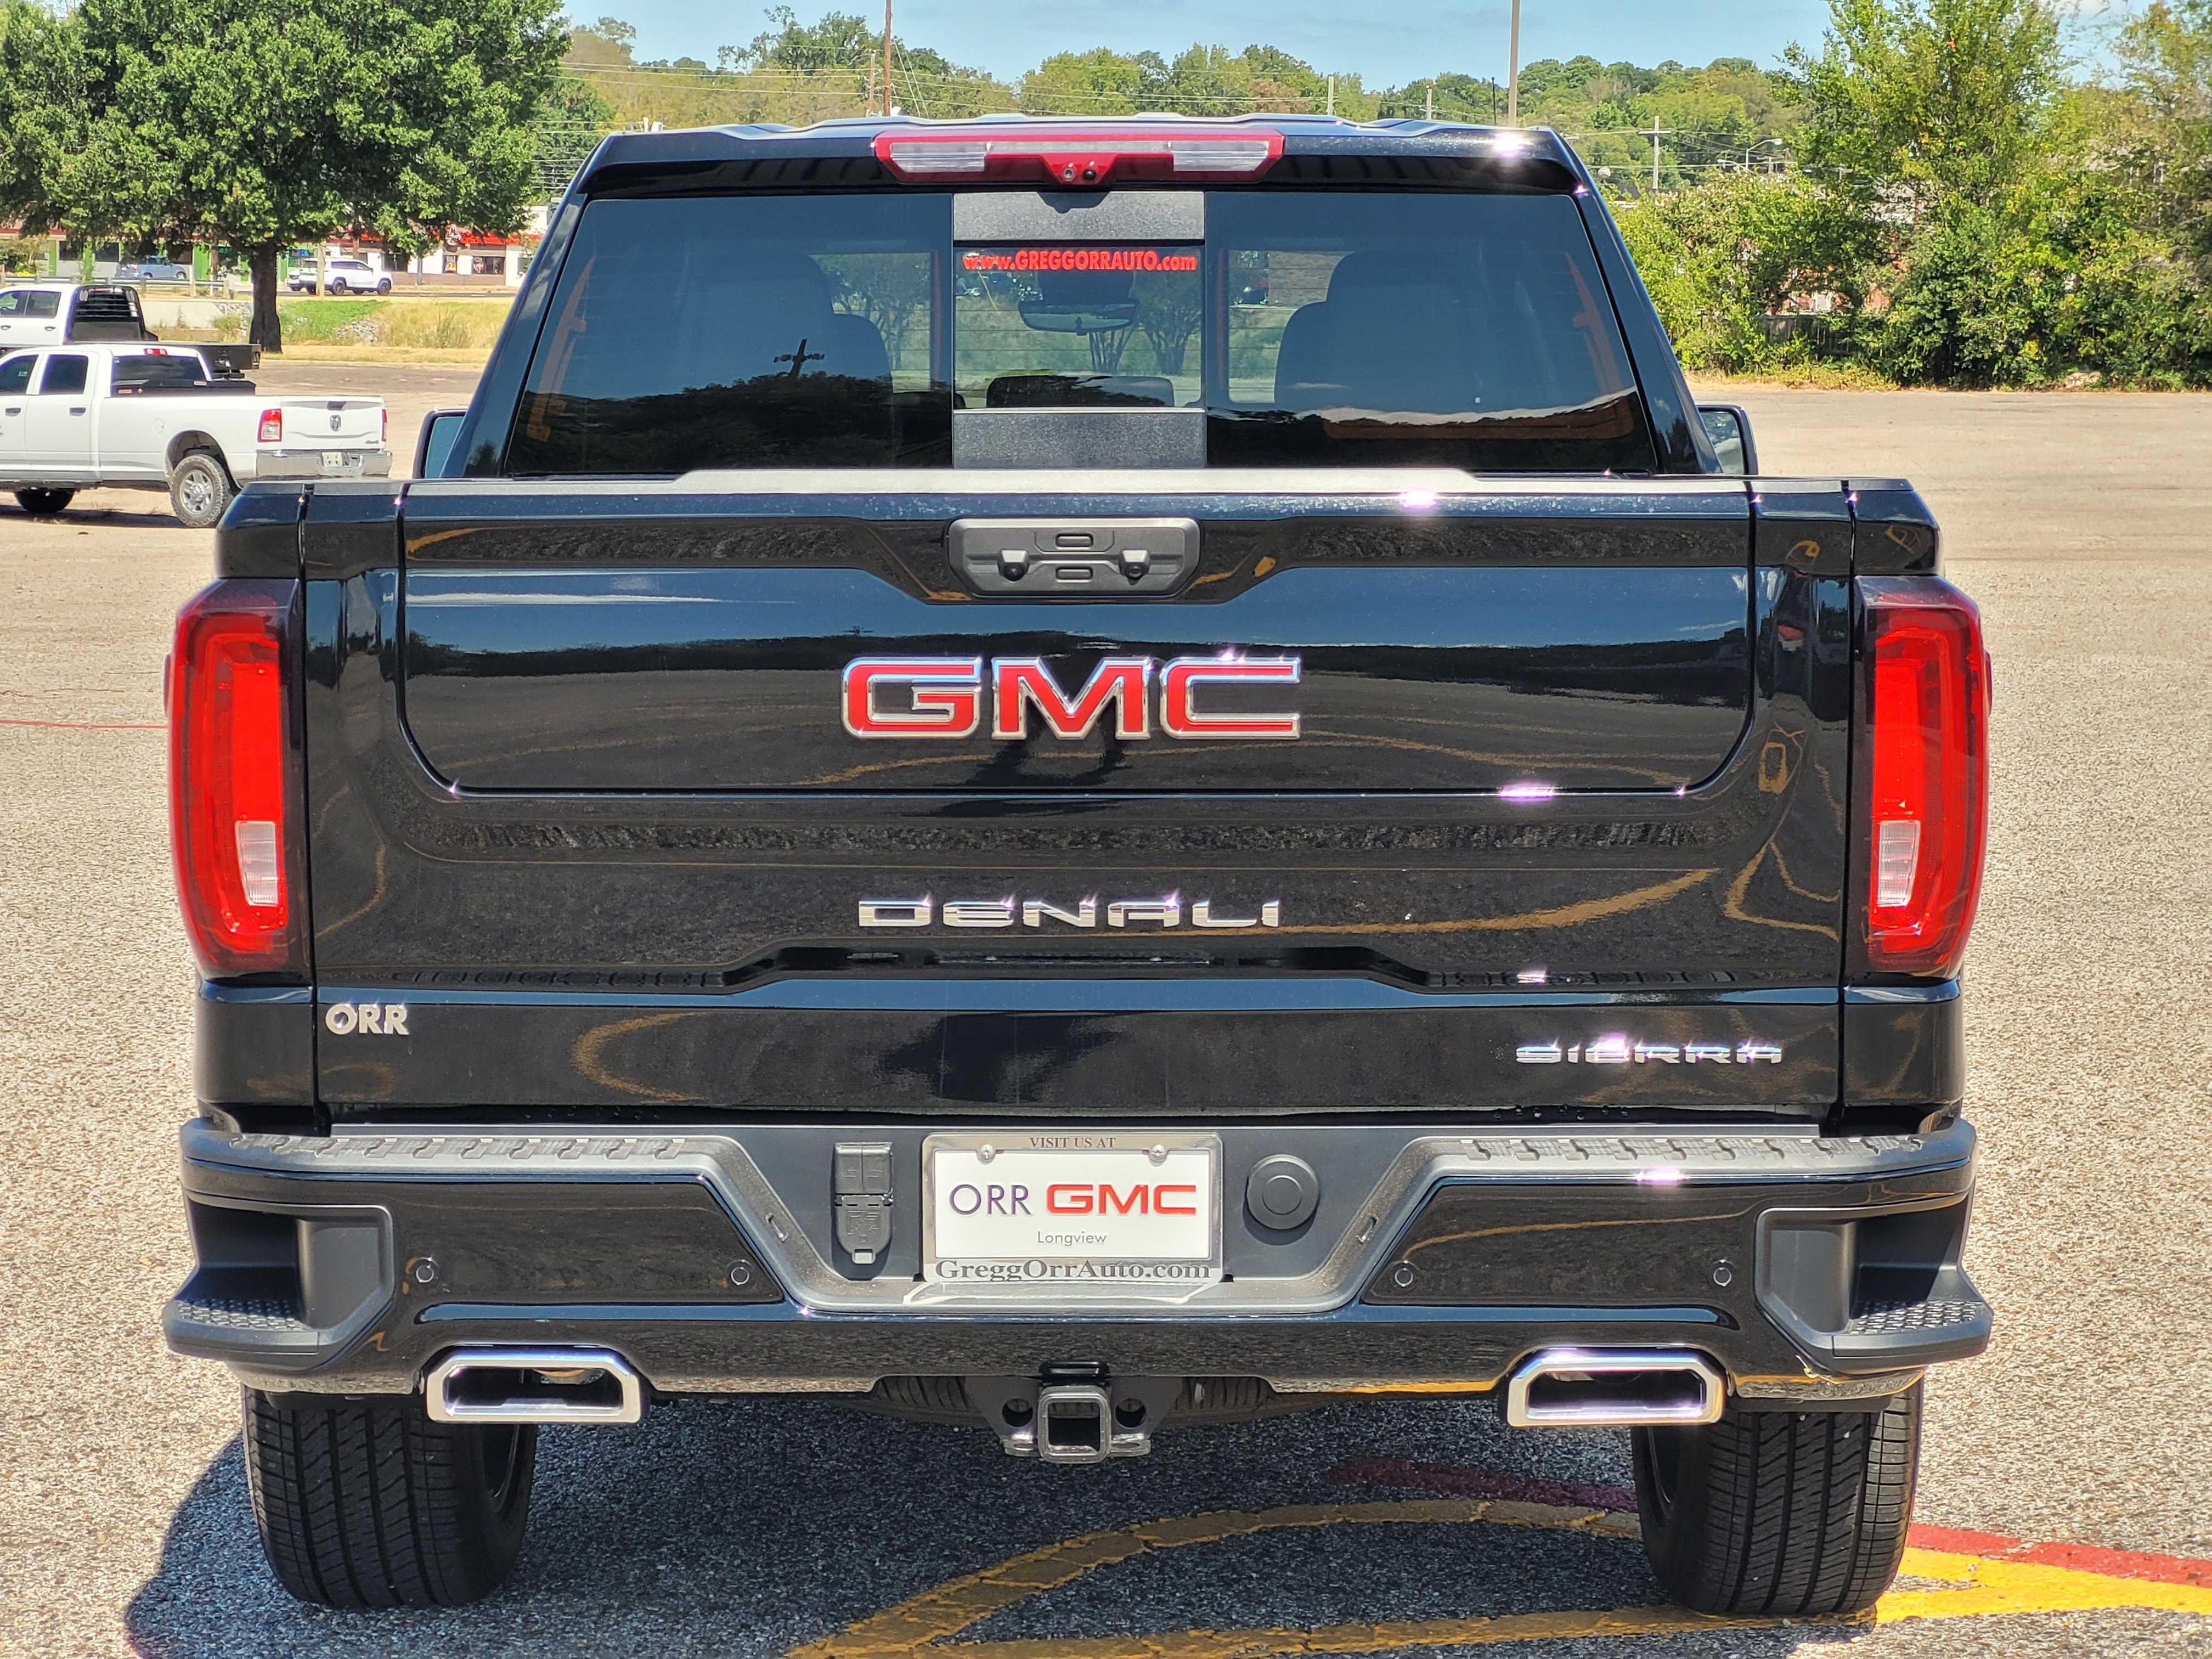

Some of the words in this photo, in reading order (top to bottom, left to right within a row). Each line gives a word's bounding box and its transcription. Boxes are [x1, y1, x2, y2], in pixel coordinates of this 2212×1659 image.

[962, 250, 1197, 270] www.GREGGORRAUTO.com
[842, 656, 1301, 740] GMC
[859, 900, 1279, 927] DENALI
[325, 1003, 410, 1035] ORR
[1516, 1045, 1782, 1064] SIERRA
[1029, 1137, 1070, 1148] VISIT
[1074, 1137, 1092, 1148] US
[1097, 1137, 1116, 1148] AT
[949, 1183, 1033, 1216] ORR
[1046, 1184, 1197, 1215] GMC
[1037, 1231, 1107, 1246] Longview
[935, 1259, 1211, 1282] GreggOrrAuto.com
